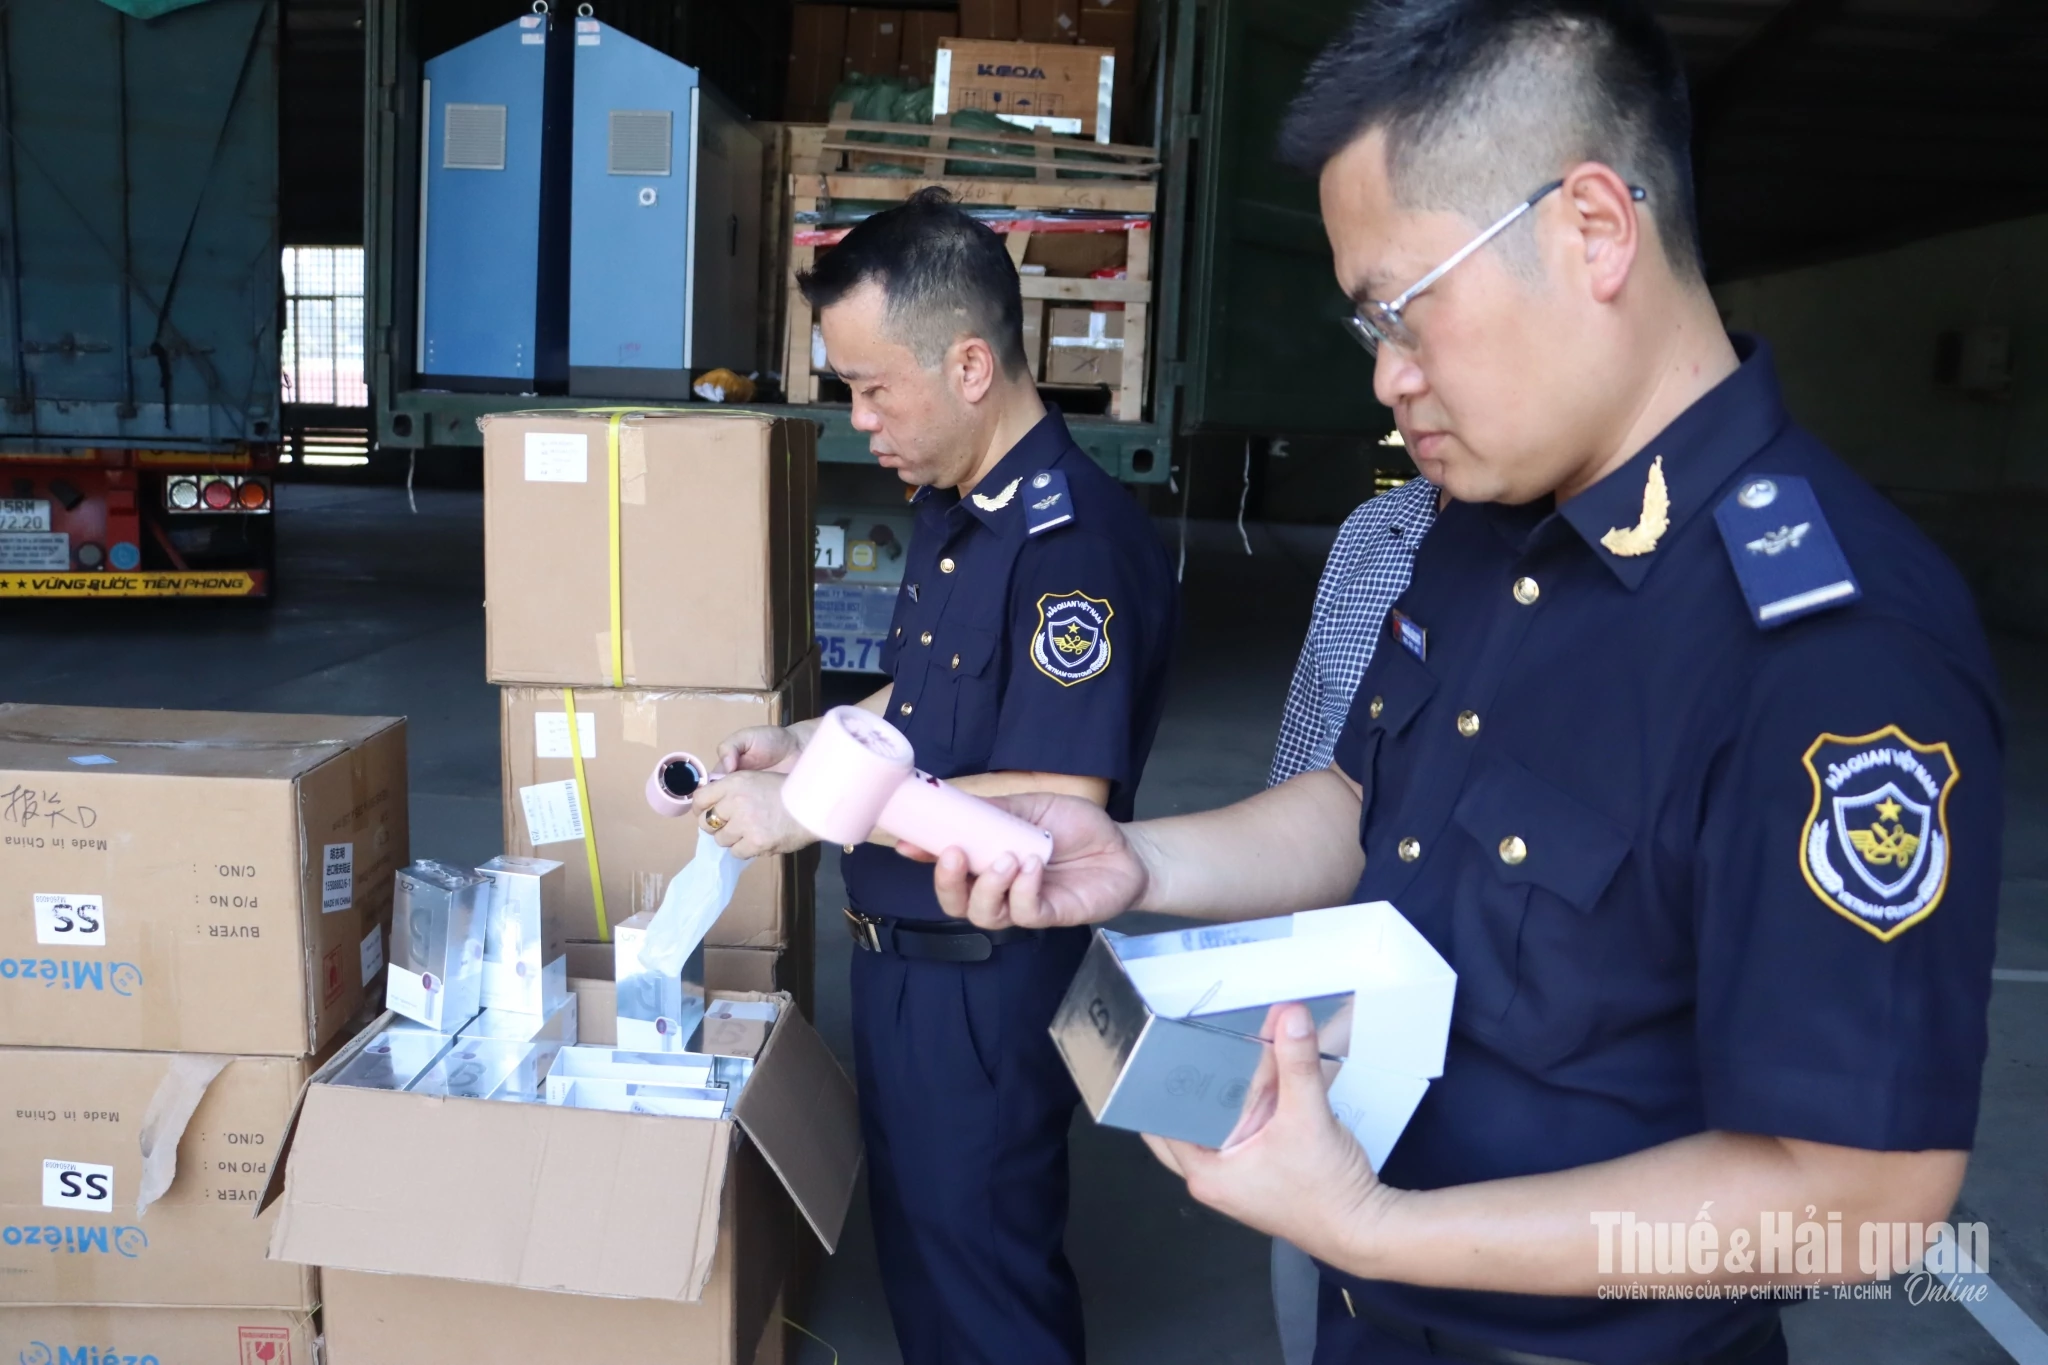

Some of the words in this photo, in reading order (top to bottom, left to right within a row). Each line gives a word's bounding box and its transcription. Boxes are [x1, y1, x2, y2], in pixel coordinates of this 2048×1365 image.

[184, 578, 244, 589] PHONG
[1057, 600, 1077, 611] QUAN
[1089, 607, 1103, 624] NAM
[1045, 663, 1067, 677] VIETNAM
[1847, 748, 1892, 773] QUAN
[1913, 764, 1940, 800] NAM
[5, 836, 45, 848] China
[53, 838, 64, 848] in
[72, 838, 107, 850] Made
[215, 864, 255, 877] C/NO.
[209, 895, 228, 907] No
[235, 896, 258, 908] P/O
[323, 899, 334, 908] MADE
[334, 898, 339, 906] IN
[340, 896, 351, 906] CHINA
[53, 904, 99, 933] SS
[209, 925, 260, 937] BUYER
[0, 958, 104, 990] Miézo
[16, 1109, 56, 1122] China
[64, 1110, 76, 1121] in
[83, 1110, 120, 1123] Made
[223, 1132, 264, 1145] C/NO.
[218, 1161, 237, 1173] No
[242, 1161, 266, 1174] P/O
[60, 1171, 108, 1200] SS
[217, 1189, 260, 1200] UYER
[3, 1226, 109, 1253] Miézo
